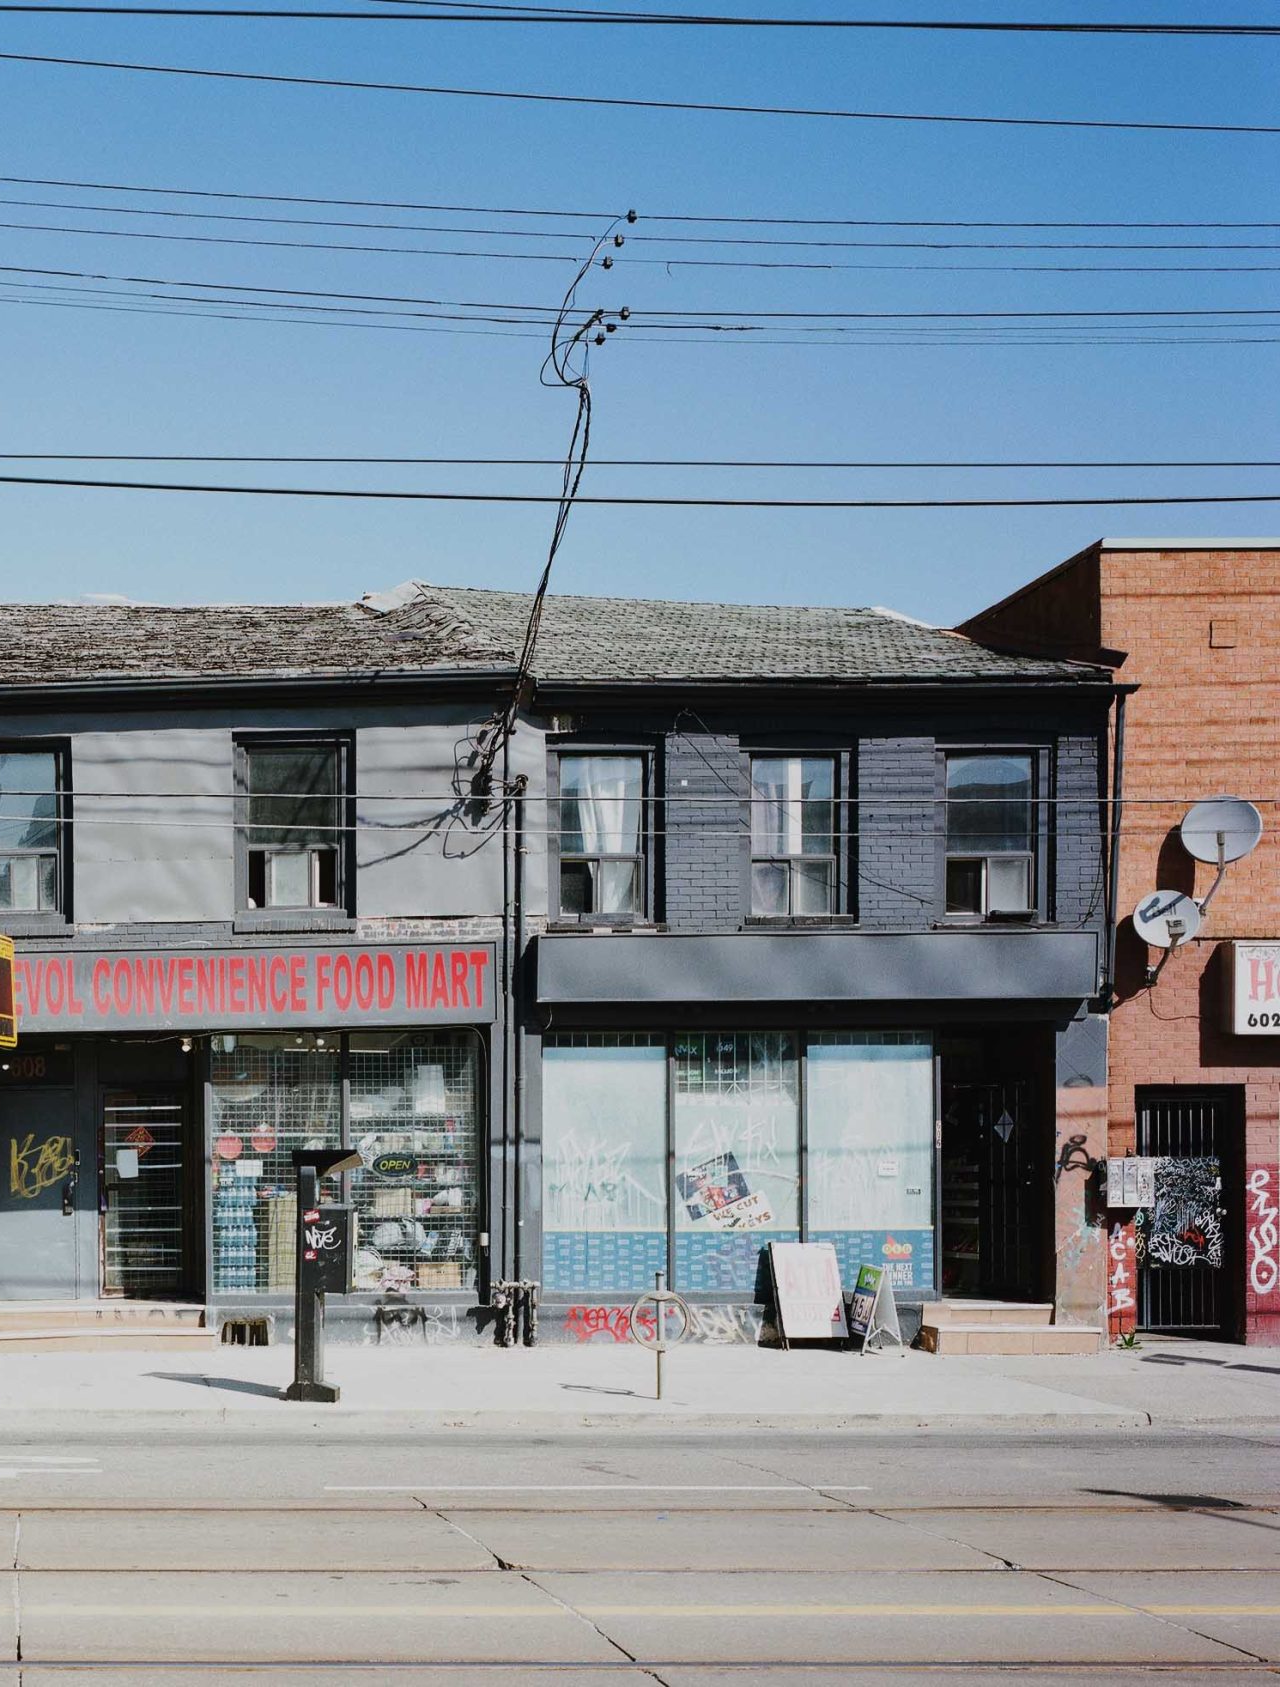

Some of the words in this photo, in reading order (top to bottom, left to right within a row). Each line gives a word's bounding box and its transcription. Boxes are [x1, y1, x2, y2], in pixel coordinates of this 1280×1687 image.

[92, 954, 307, 1016] CONVENIENCE
[315, 951, 395, 1012] FOOD
[406, 949, 488, 1009] MART
[1248, 956, 1280, 1002] H
[1247, 1013, 1280, 1028] 602
[11, 1055, 46, 1077] 608
[379, 1160, 412, 1171] OPEN
[736, 1195, 759, 1211] CUT
[896, 1262, 913, 1272] NEXT
